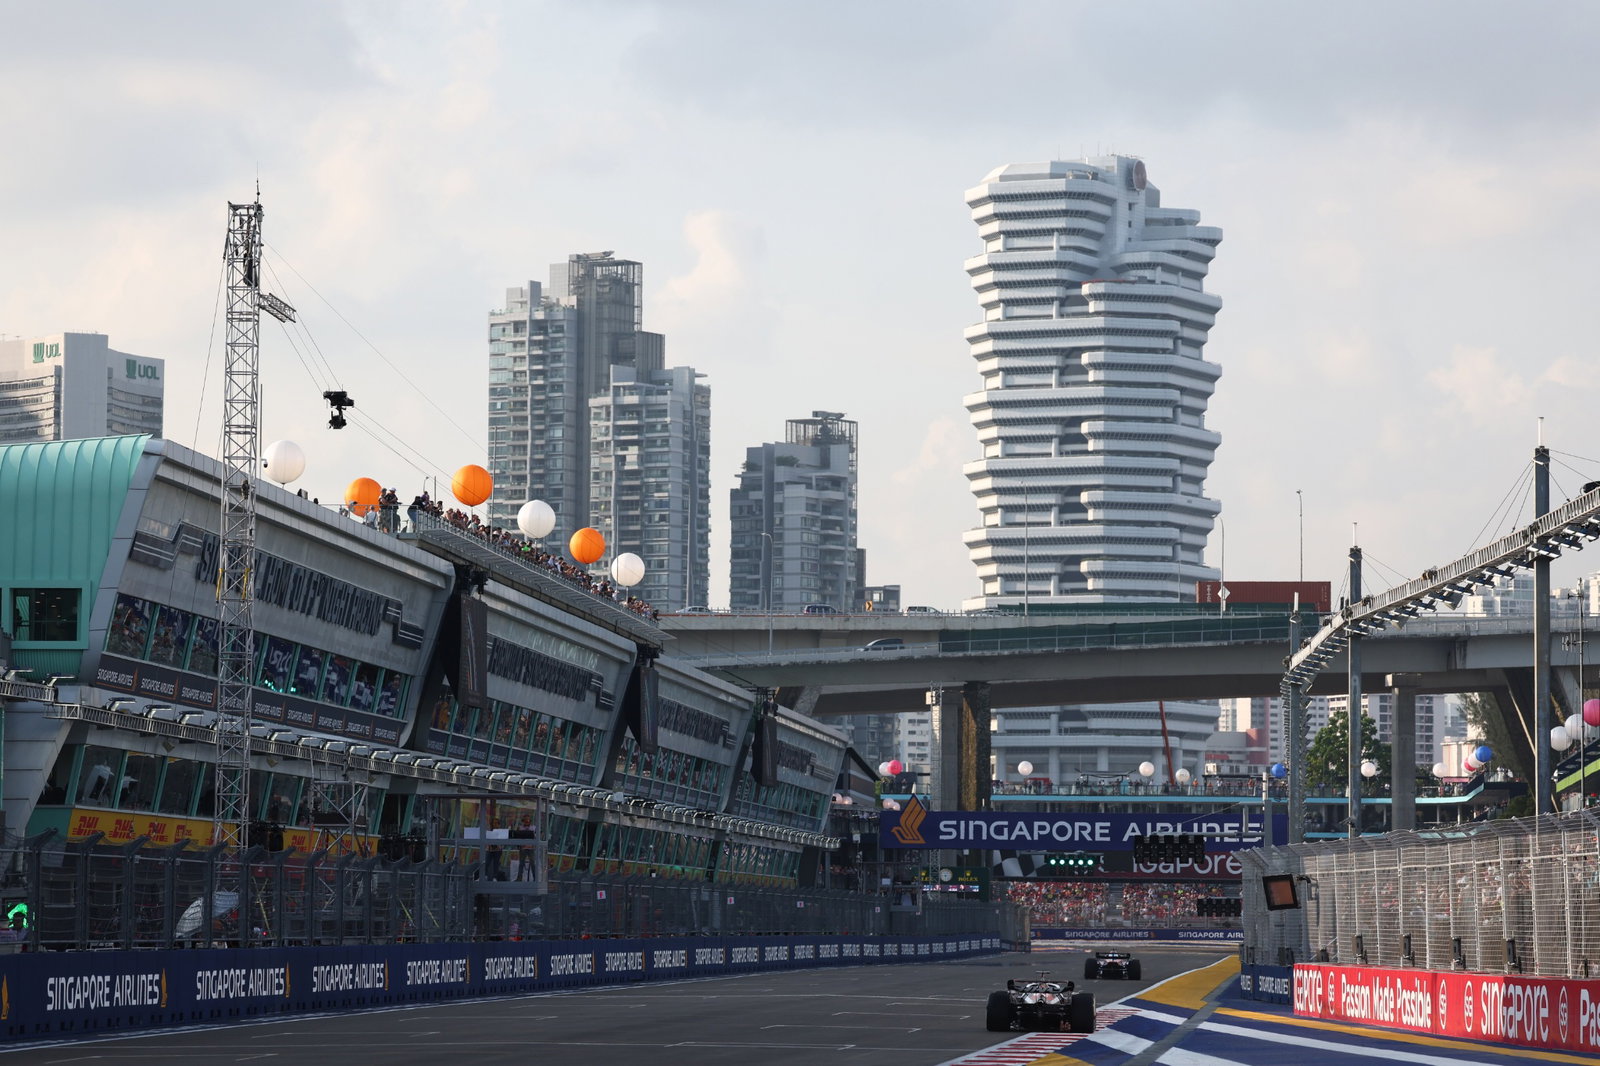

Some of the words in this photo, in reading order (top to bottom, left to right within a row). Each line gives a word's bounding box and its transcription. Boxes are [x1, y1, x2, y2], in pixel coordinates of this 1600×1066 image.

[46, 343, 62, 358] UOL
[138, 364, 160, 380] UOL
[938, 820, 1110, 842] SINGAPORE
[407, 960, 440, 985] SINGAPORE
[442, 958, 466, 984] AIRLINES
[485, 956, 512, 981] SINGAPORE
[514, 956, 535, 979] AIRLINES
[550, 954, 574, 976] SINGAPORE
[574, 953, 592, 974] AIRLINES
[605, 952, 626, 972] SINGAPORE
[627, 952, 642, 970] AIRLINES
[196, 967, 246, 1001] SINGAPORE
[248, 967, 285, 996] AIRLINES
[312, 964, 353, 993] SINGAPORE
[354, 962, 385, 990] AIRLINES
[46, 974, 110, 1012] SINGAPORE
[113, 973, 160, 1008] AIRLINES
[1341, 972, 1371, 1020] Passion
[1372, 976, 1394, 1024] Made
[1396, 977, 1431, 1029] Possible
